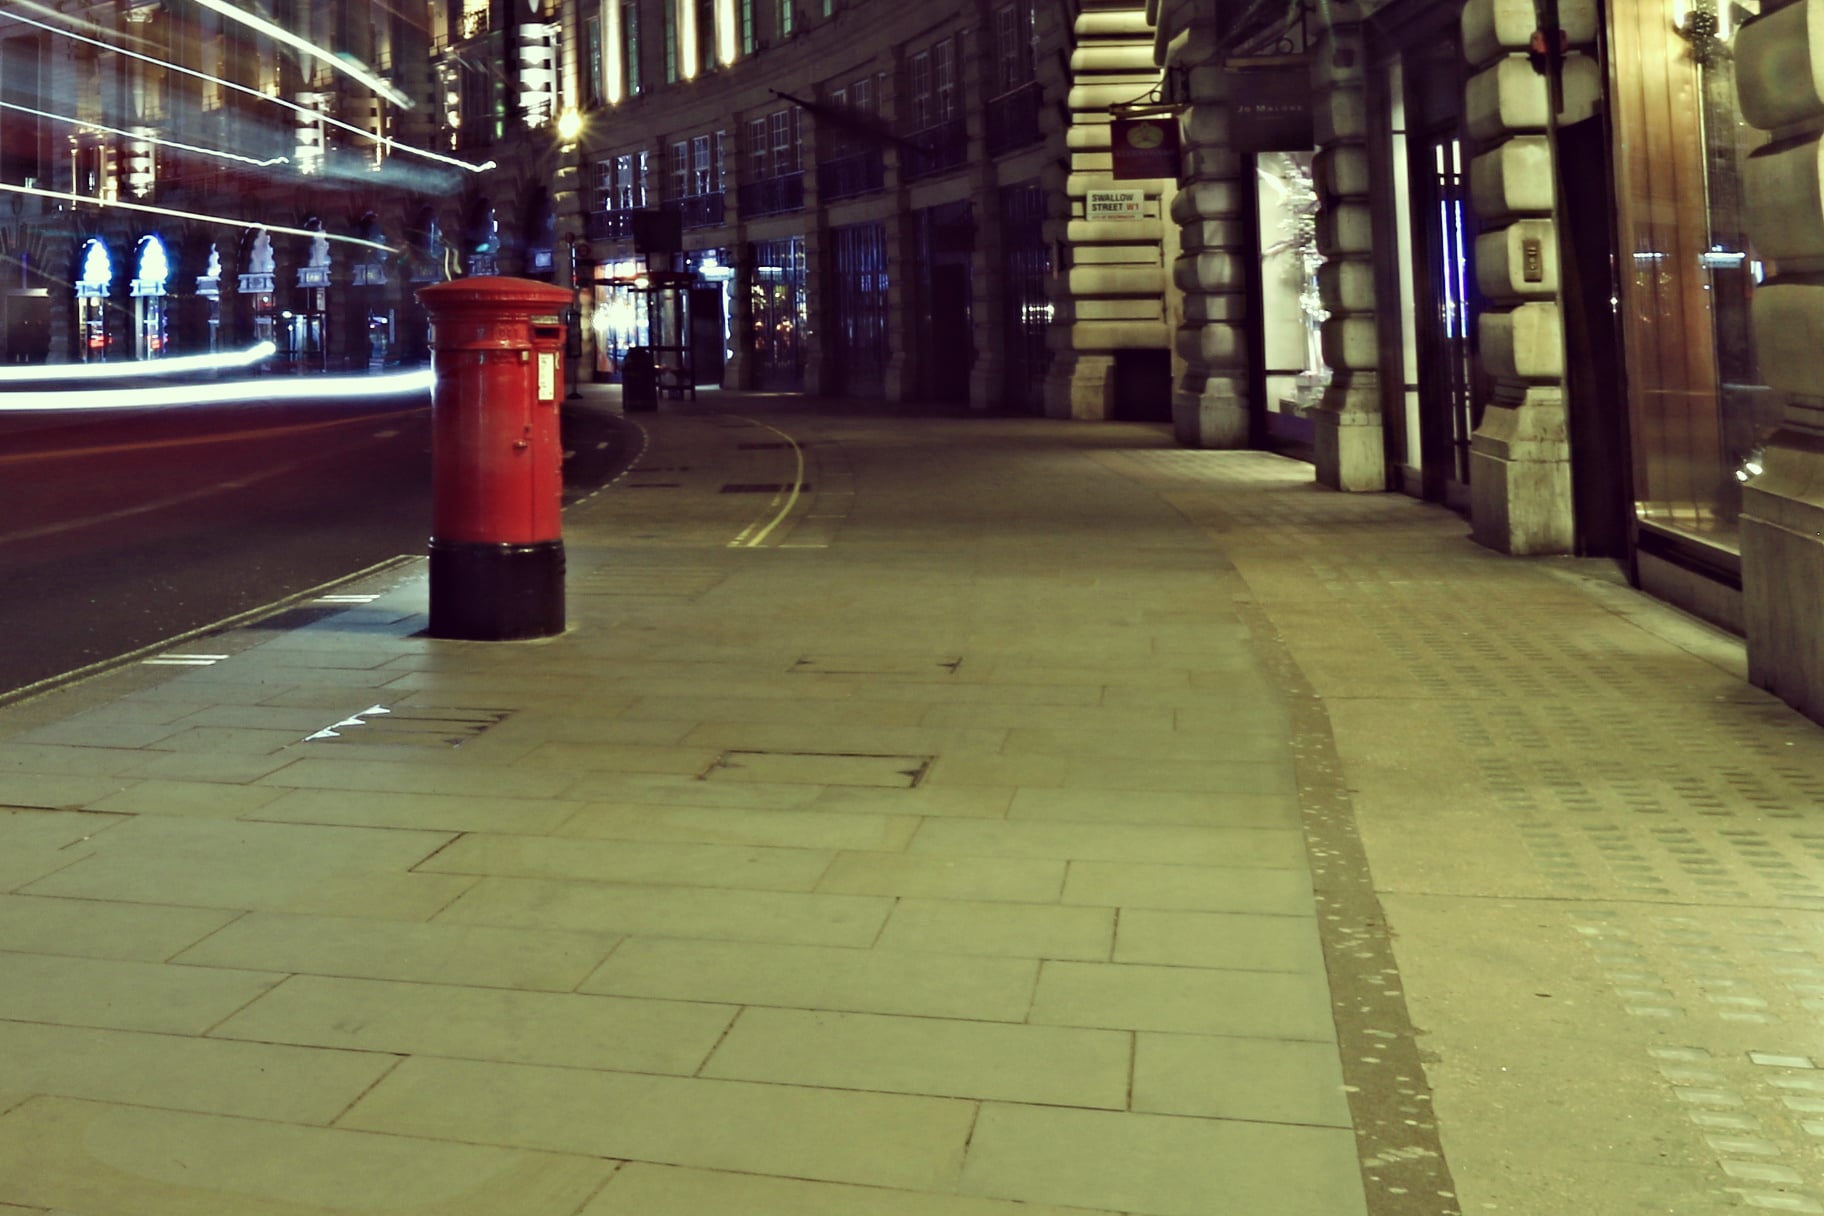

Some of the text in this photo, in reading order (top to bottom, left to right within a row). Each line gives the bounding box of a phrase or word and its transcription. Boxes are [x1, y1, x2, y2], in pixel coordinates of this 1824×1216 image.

[1091, 193, 1134, 202] SWALLOW
[1091, 202, 1139, 211] STREET W1
